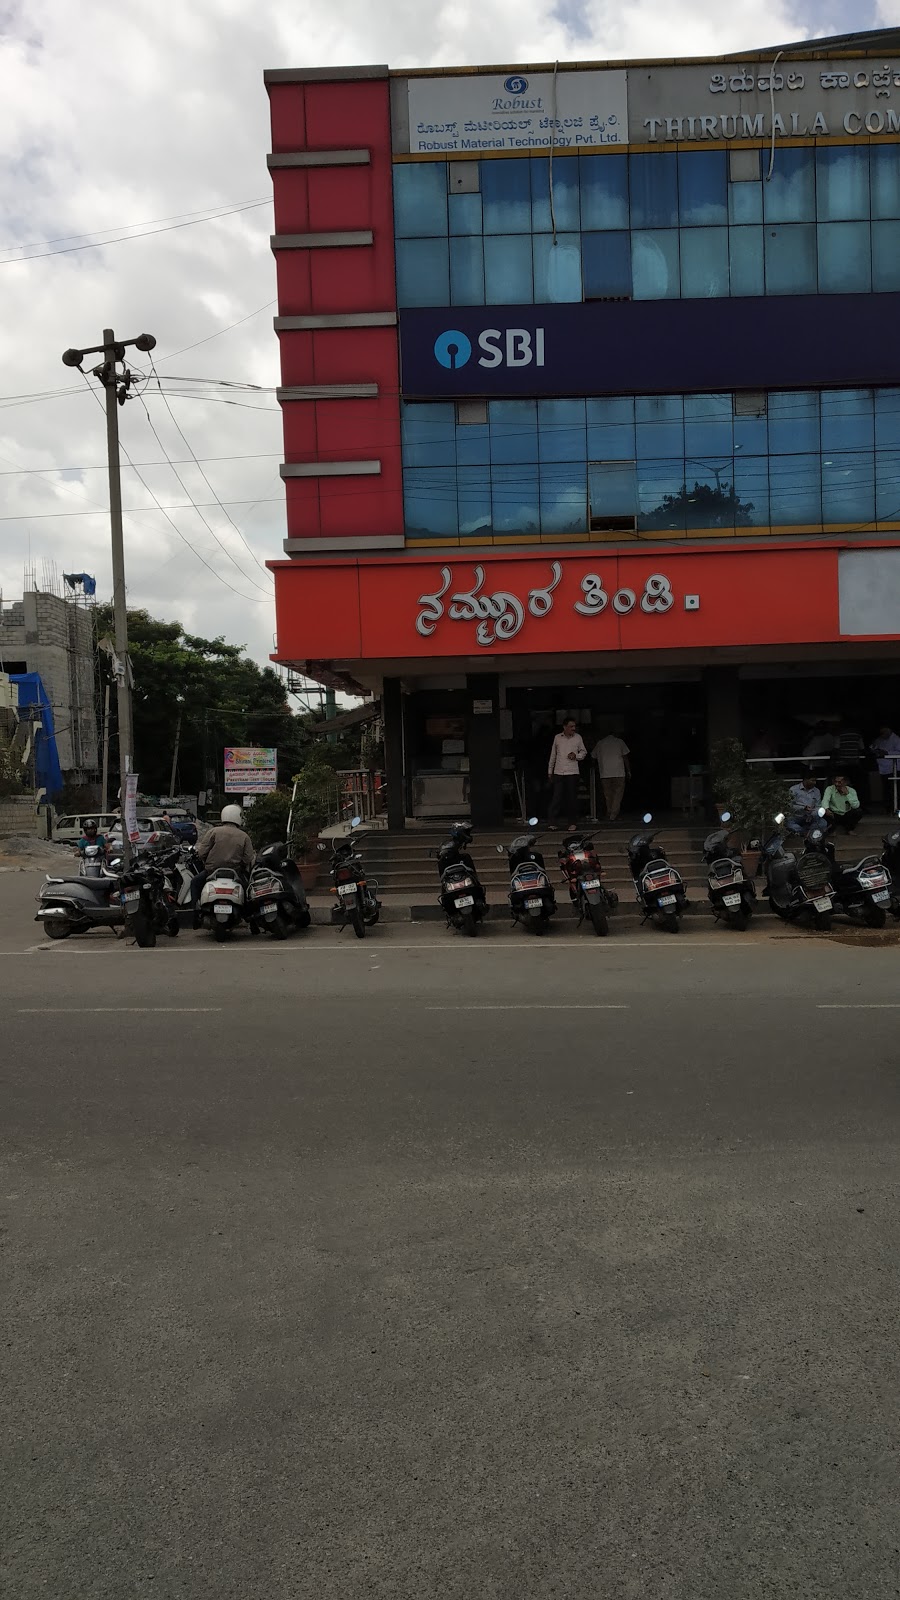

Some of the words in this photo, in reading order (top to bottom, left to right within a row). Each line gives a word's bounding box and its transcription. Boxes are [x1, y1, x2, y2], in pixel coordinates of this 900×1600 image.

[709, 67, 806, 94] ತಿರುಮಲ
[492, 95, 543, 110] Robust
[418, 139, 458, 150] Robust
[461, 137, 505, 149] Material
[508, 135, 572, 148] Technology
[575, 134, 596, 144] Pvt.
[600, 133, 621, 143] Ltd.
[643, 111, 830, 143] THIRUMALA
[478, 328, 545, 368] SBI
[415, 560, 563, 647] ನಮ್ಮೂರ
[573, 572, 675, 616] ತಿಂಡಿ
